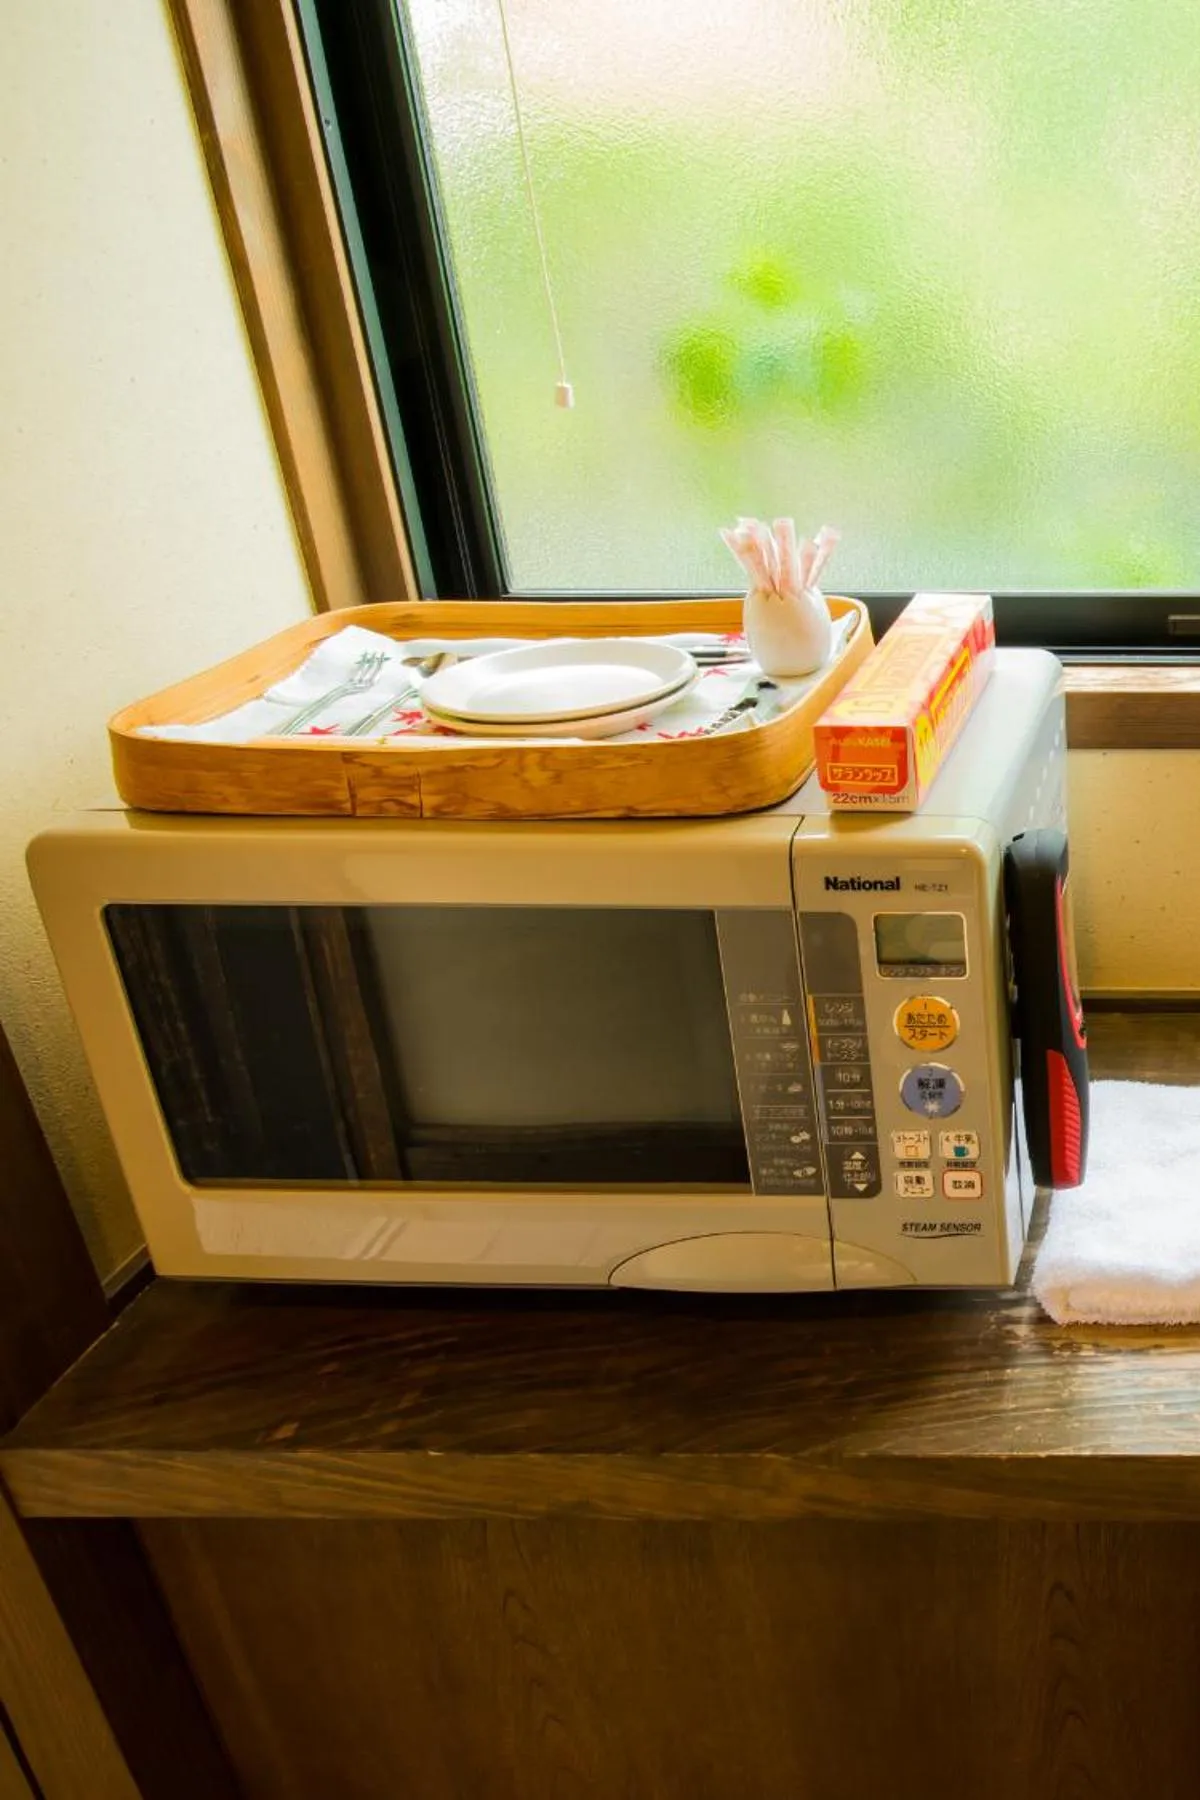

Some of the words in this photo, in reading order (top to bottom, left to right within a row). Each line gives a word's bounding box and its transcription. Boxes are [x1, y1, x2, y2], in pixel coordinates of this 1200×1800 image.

[832, 768, 892, 781] サランラップ
[824, 876, 900, 891] National
[908, 1028, 948, 1040] スタート
[901, 1222, 937, 1233] STEAM
[939, 1222, 982, 1233] SENSOR
